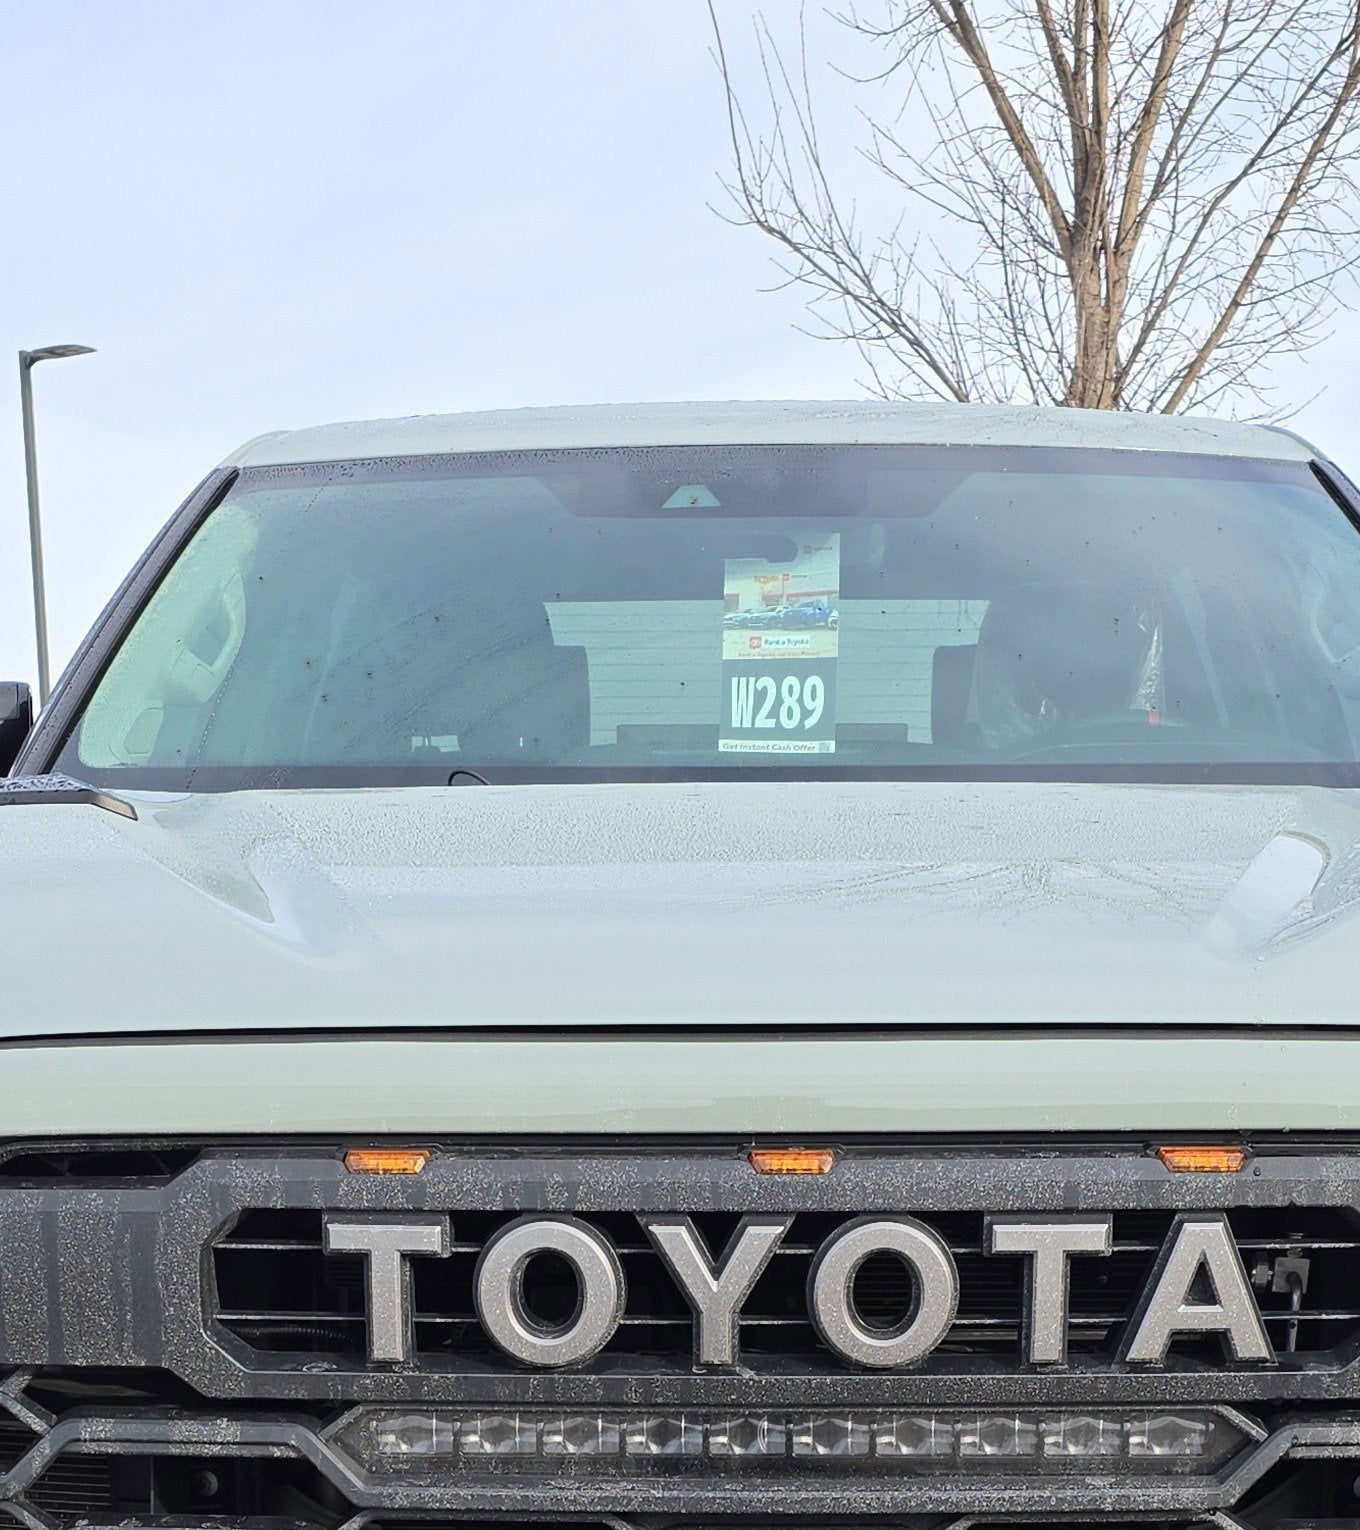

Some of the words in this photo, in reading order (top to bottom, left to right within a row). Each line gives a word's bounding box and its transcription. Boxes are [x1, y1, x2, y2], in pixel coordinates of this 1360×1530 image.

[731, 675, 825, 730] W289
[723, 742, 738, 750] Get
[740, 742, 770, 751] Instant
[771, 743, 792, 752] Cash
[793, 743, 816, 752] Offer
[322, 1213, 1273, 1371] TOYOTA
